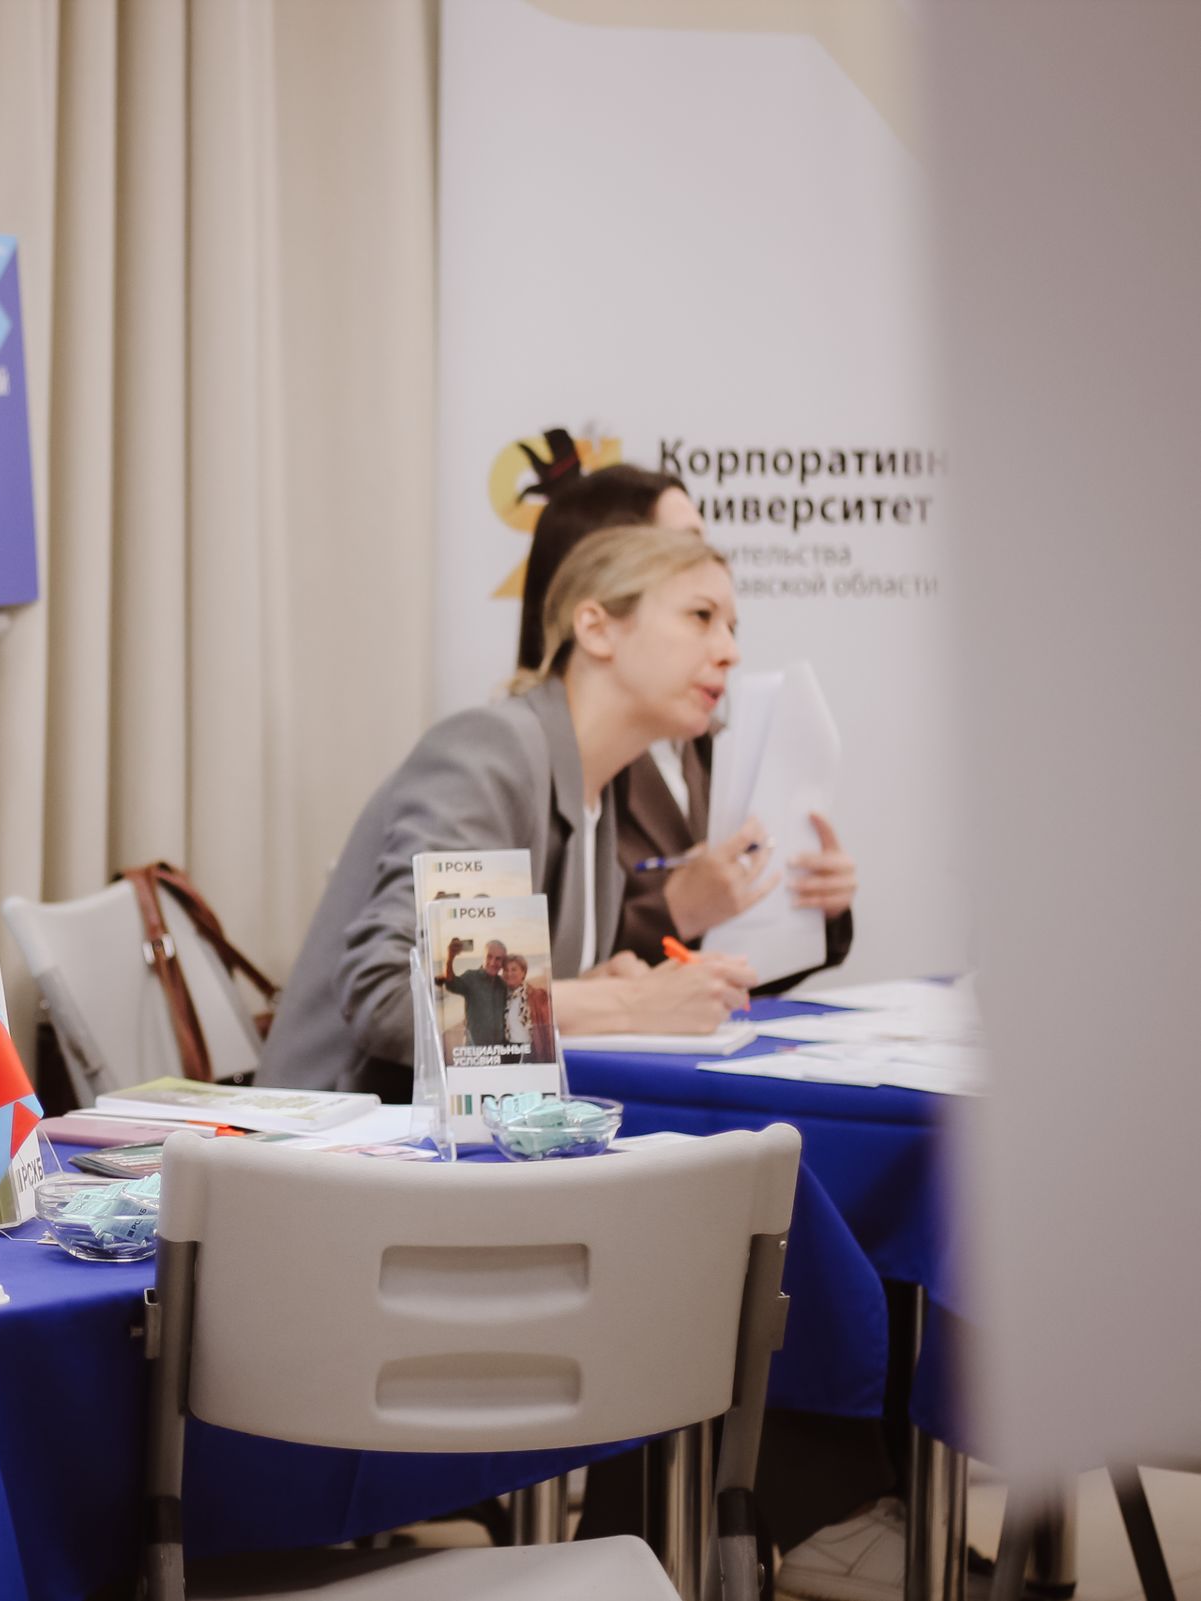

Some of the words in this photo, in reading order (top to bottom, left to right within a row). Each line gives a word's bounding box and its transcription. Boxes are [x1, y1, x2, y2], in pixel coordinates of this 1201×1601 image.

[445, 861, 483, 873] РСХБ
[459, 906, 497, 919] РСХБ
[452, 1043, 532, 1057] СПЕЦИАЛЬНЫЕ
[453, 1055, 502, 1067] УСЛОВИЯ
[21, 1157, 44, 1191] РСХБ
